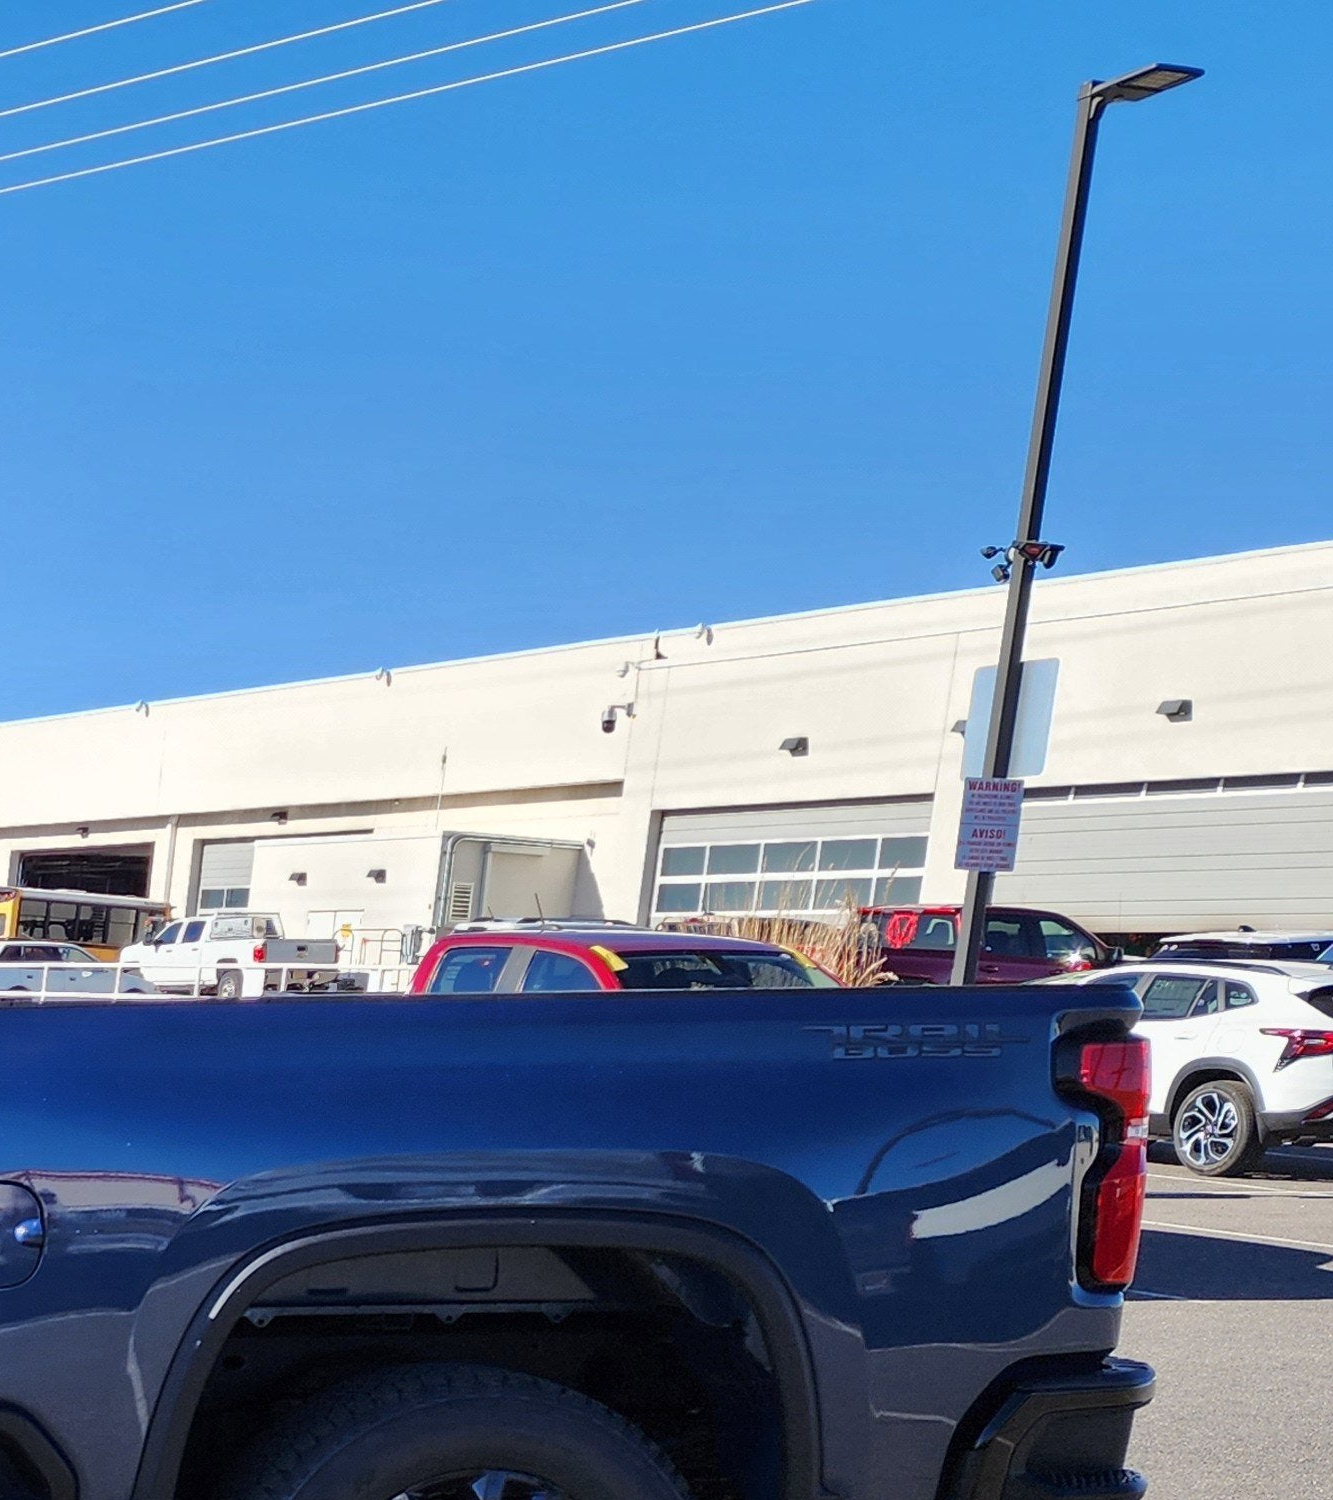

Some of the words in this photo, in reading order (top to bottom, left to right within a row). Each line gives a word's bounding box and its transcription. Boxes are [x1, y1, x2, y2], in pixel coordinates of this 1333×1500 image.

[969, 780, 1020, 791] WARNING!
[971, 828, 1005, 839] AVISO!
[833, 1043, 1002, 1060] BOSS
